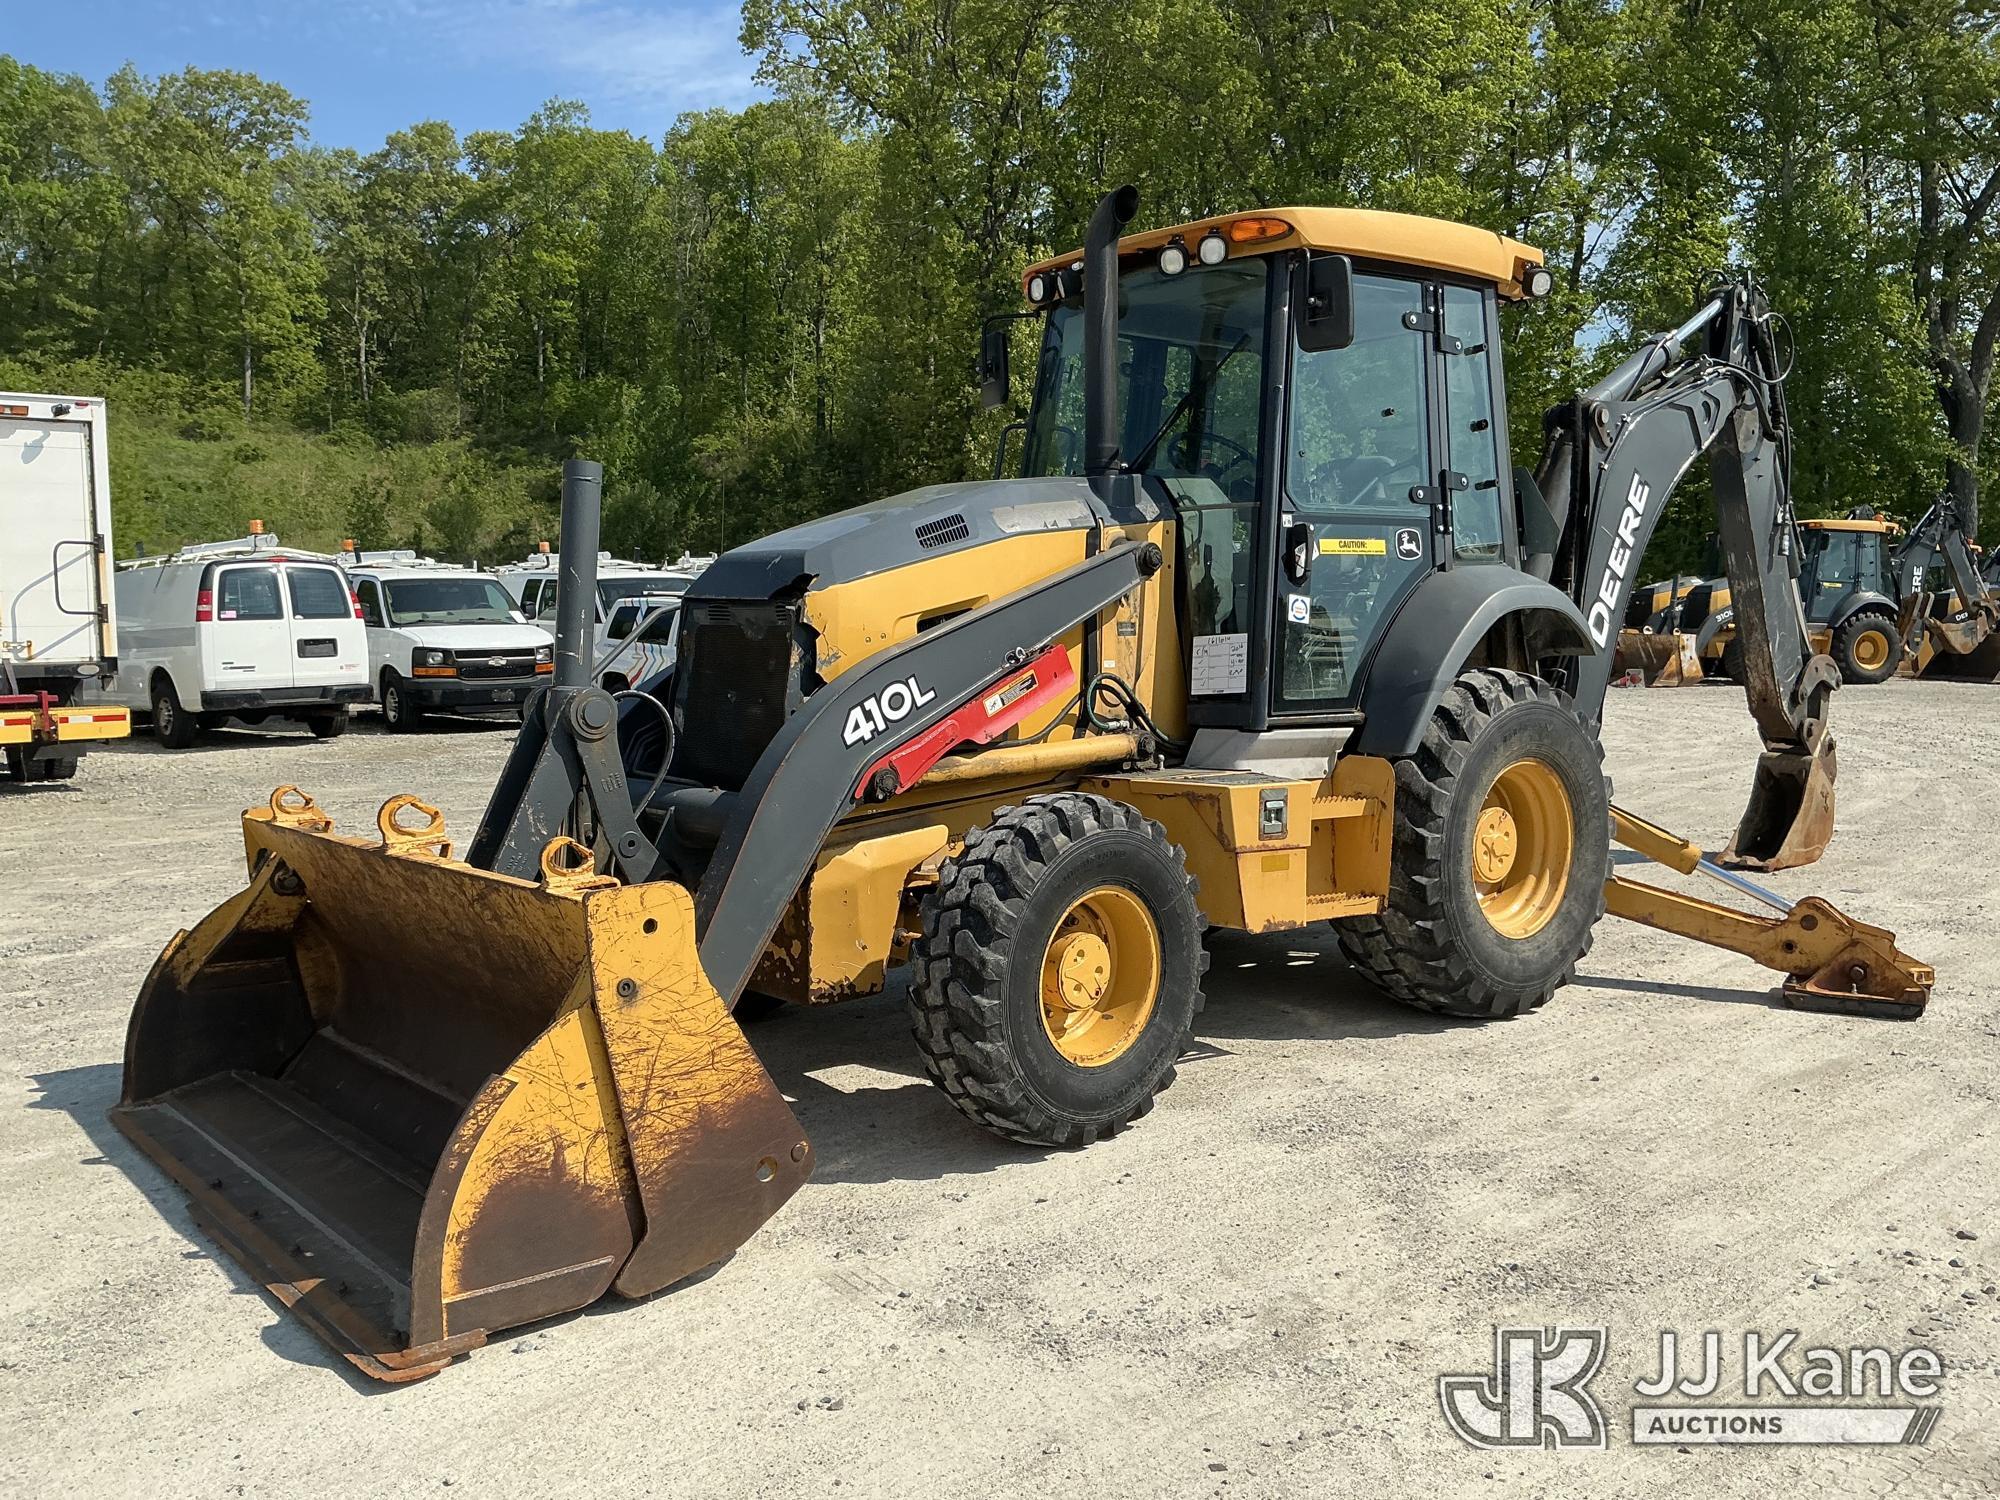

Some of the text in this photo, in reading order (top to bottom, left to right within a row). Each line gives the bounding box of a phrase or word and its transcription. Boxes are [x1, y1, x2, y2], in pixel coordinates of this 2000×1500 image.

[1338, 540, 1368, 549] CAUTION:
[1588, 472, 1650, 649] DEERE
[1912, 565, 1923, 594] ERE
[1715, 610, 1734, 622] 310L
[841, 674, 937, 749] 410L
